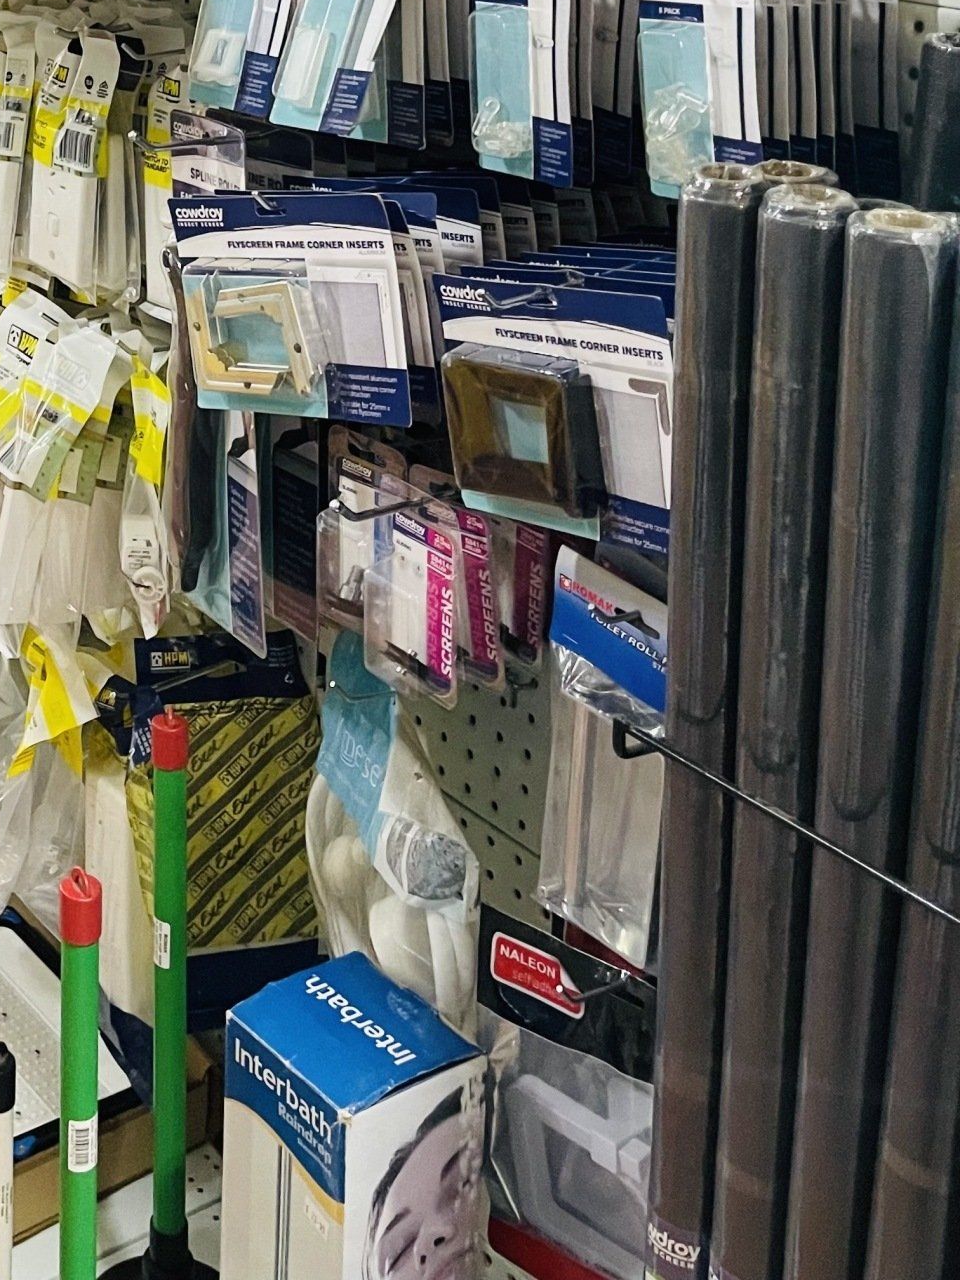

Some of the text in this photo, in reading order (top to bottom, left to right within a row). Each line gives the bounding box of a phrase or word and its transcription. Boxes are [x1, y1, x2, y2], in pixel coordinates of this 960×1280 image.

[664, 7, 681, 16] PACK
[190, 167, 218, 187] SPLINE
[176, 205, 224, 220] cowdroy
[227, 239, 274, 250] FLYSCREEN
[275, 240, 305, 250] FRAME
[307, 240, 344, 250] CORNER
[346, 240, 385, 250] INSERTS
[441, 232, 475, 245] INSERTS
[439, 285, 485, 301] cowdro
[496, 328, 664, 361] FLYSCREEN FRAME CORNER INSERTS
[395, 512, 426, 536] cowdroy
[527, 561, 543, 647] SCREENS
[572, 581, 615, 615] ROMAK
[440, 586, 454, 678] SCREENS
[479, 570, 499, 661] SCREENS
[165, 652, 189, 667] HPM
[628, 637, 662, 664] ROLL
[191, 740, 222, 773] Excel
[249, 725, 277, 759] Excel
[231, 754, 251, 781] HPM
[232, 781, 262, 815] Excel
[214, 810, 234, 836] HPM
[272, 818, 304, 853] Excel
[215, 836, 246, 869] Excel
[256, 875, 286, 910] Excel
[201, 892, 232, 927] Excel
[500, 943, 556, 979] NALEON
[305, 973, 417, 1066] Interbath
[235, 1037, 332, 1145] Interbath
